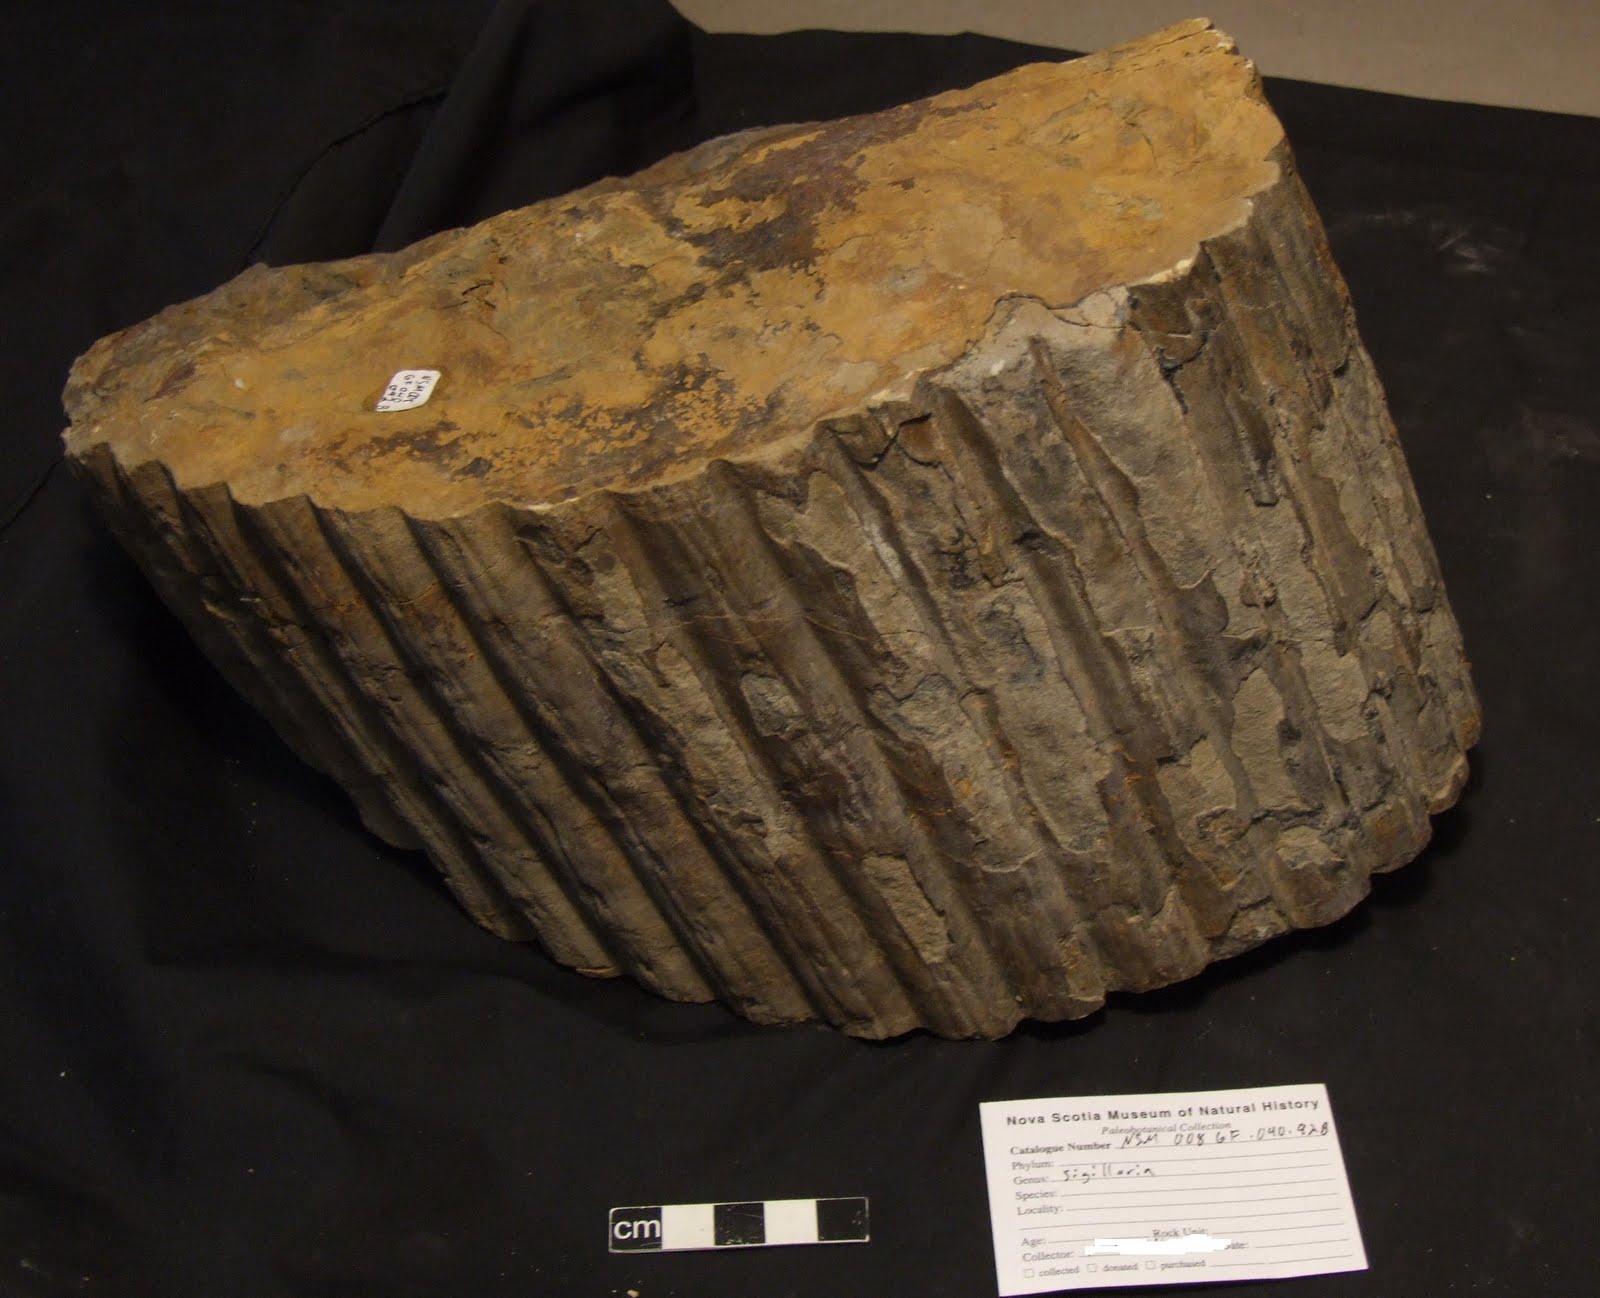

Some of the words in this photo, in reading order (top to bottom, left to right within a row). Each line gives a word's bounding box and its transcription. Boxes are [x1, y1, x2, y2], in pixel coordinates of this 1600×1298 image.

[1007, 1116, 1046, 1126] Nova
[1052, 1111, 1102, 1123] Scotia
[1107, 1109, 1172, 1120] Museum
[1178, 1107, 1193, 1117] of
[1199, 1103, 1256, 1116] Natural
[1262, 1099, 1319, 1112] History
[1101, 1123, 1176, 1136] Paleobotanical
[1179, 1122, 1232, 1132] Collection
[1010, 1144, 1065, 1156] Catalogue
[1067, 1141, 1111, 1151] Number
[1012, 1160, 1054, 1171] Phylum:
[1013, 1175, 1049, 1186] Genus:
[1015, 1190, 1057, 1201] Species:
[1017, 1204, 1064, 1216] Locality:
[613, 1218, 661, 1240] cm
[1021, 1238, 1047, 1248] Age:
[1152, 1229, 1181, 1239] Rock
[1022, 1251, 1075, 1262] Collector:
[1038, 1265, 1080, 1277] collected
[1102, 1263, 1139, 1272] donated
[1161, 1259, 1206, 1271] purchased
